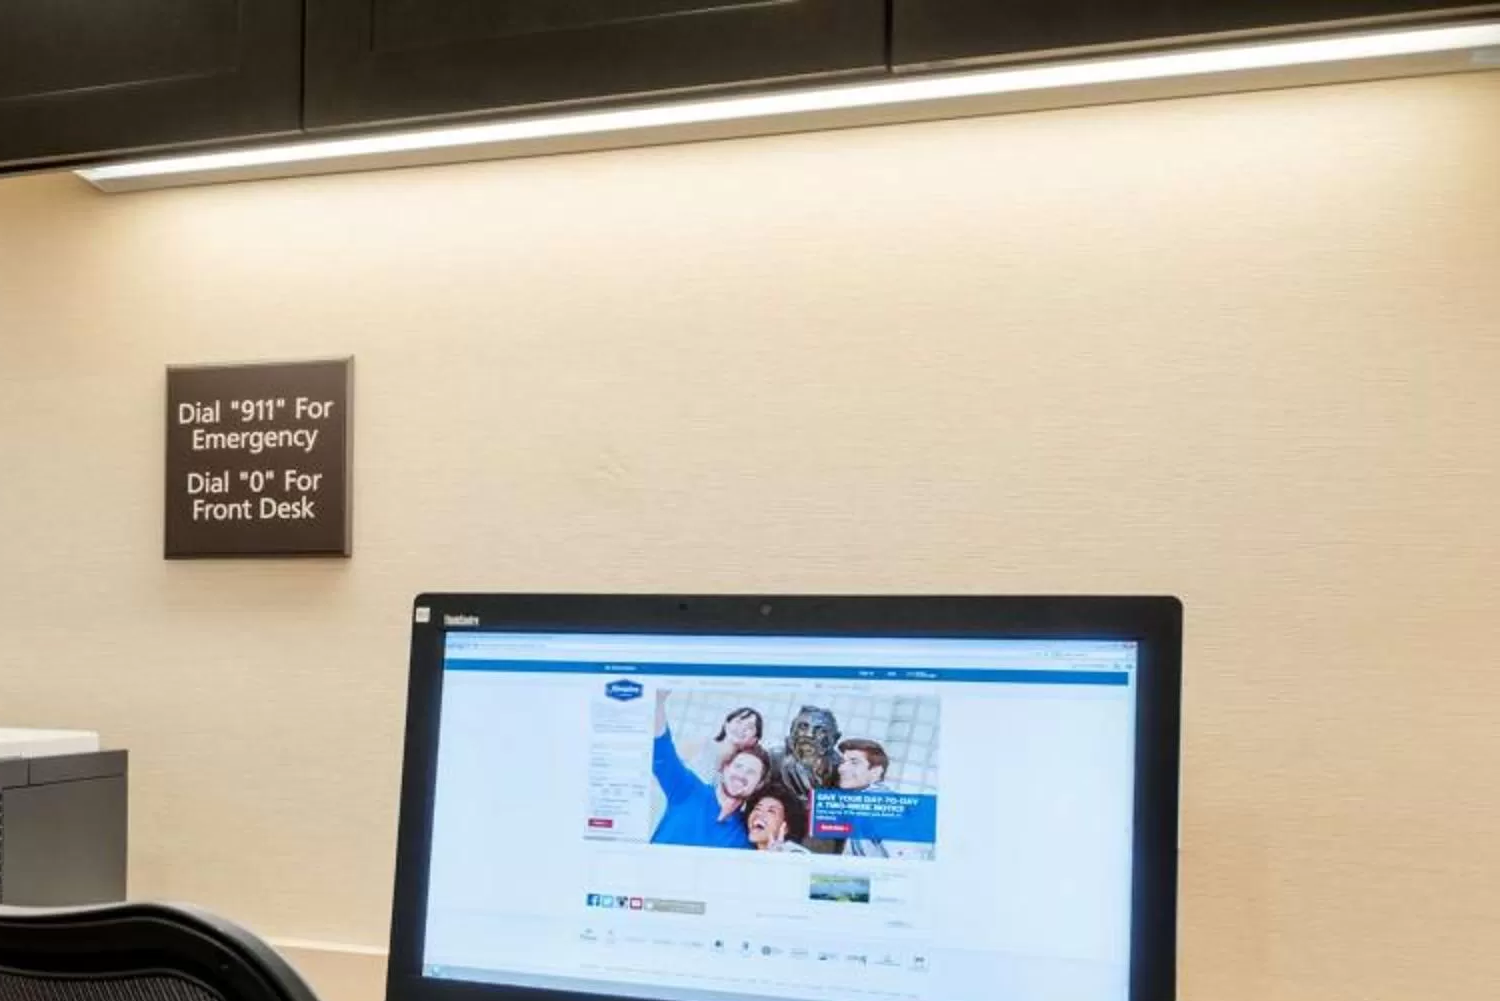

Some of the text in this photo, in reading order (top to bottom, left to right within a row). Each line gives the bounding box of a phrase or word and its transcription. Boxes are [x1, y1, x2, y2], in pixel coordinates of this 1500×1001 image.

[178, 397, 334, 424] Dial "911" For
[192, 428, 318, 454] Emergency
[187, 469, 322, 494] Dial "0" For
[193, 495, 315, 521] Front Desk
